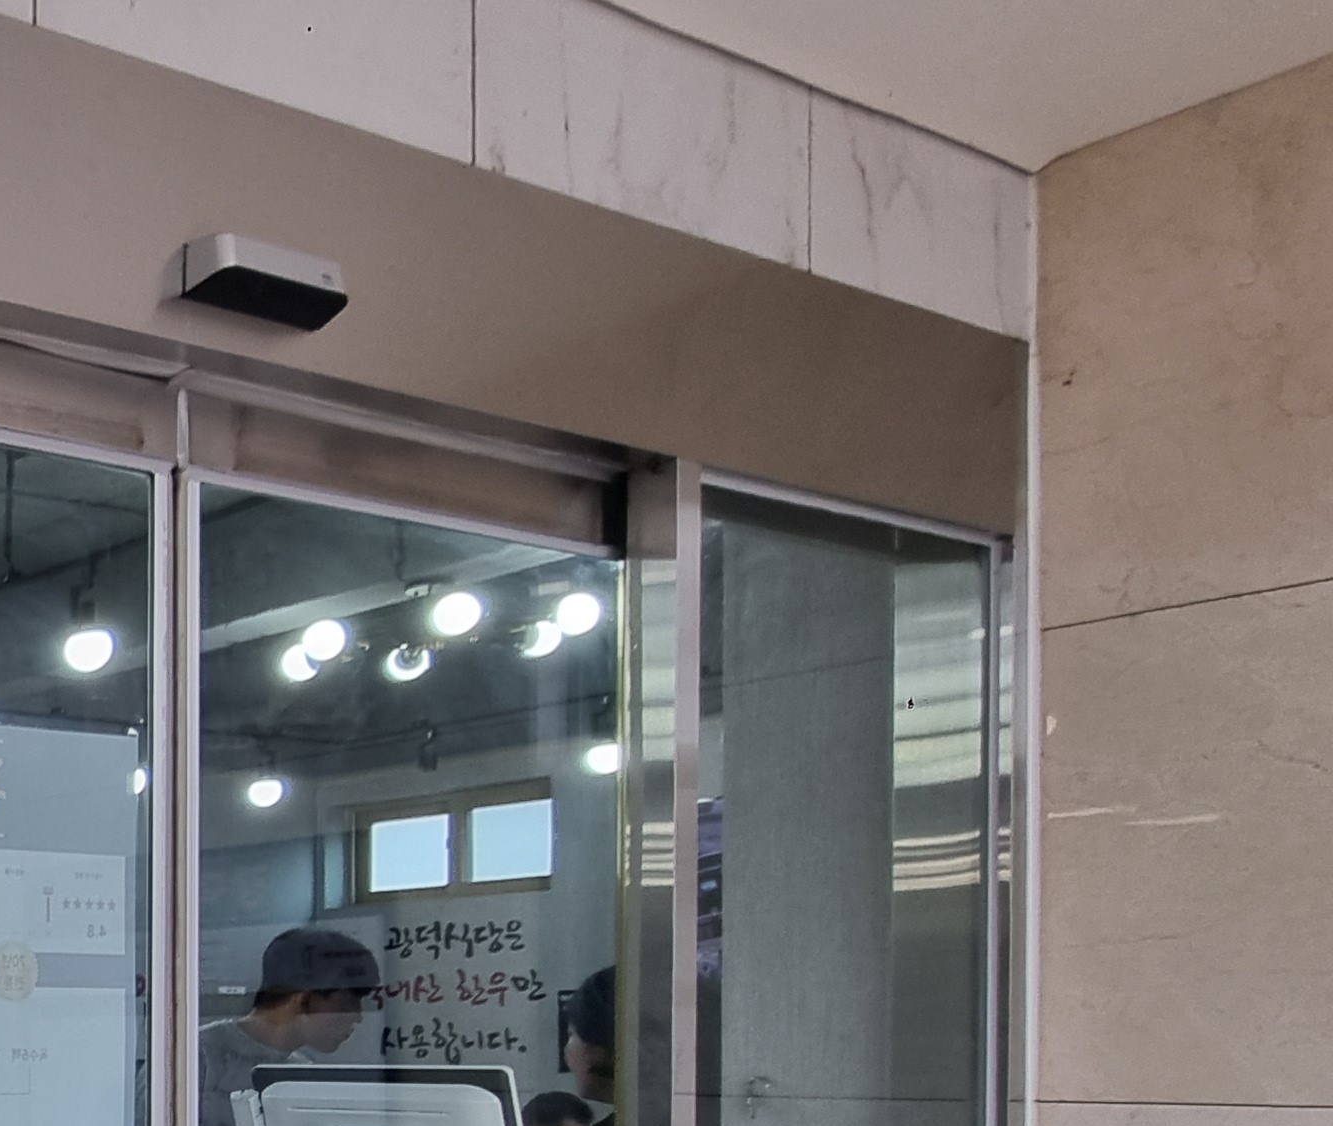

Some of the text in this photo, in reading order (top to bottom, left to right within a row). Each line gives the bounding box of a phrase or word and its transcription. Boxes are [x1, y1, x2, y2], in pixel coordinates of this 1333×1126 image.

[384, 919, 525, 959] 광덕식당은
[456, 968, 547, 1007] 한우만
[380, 1018, 528, 1064] 사용합니다.
